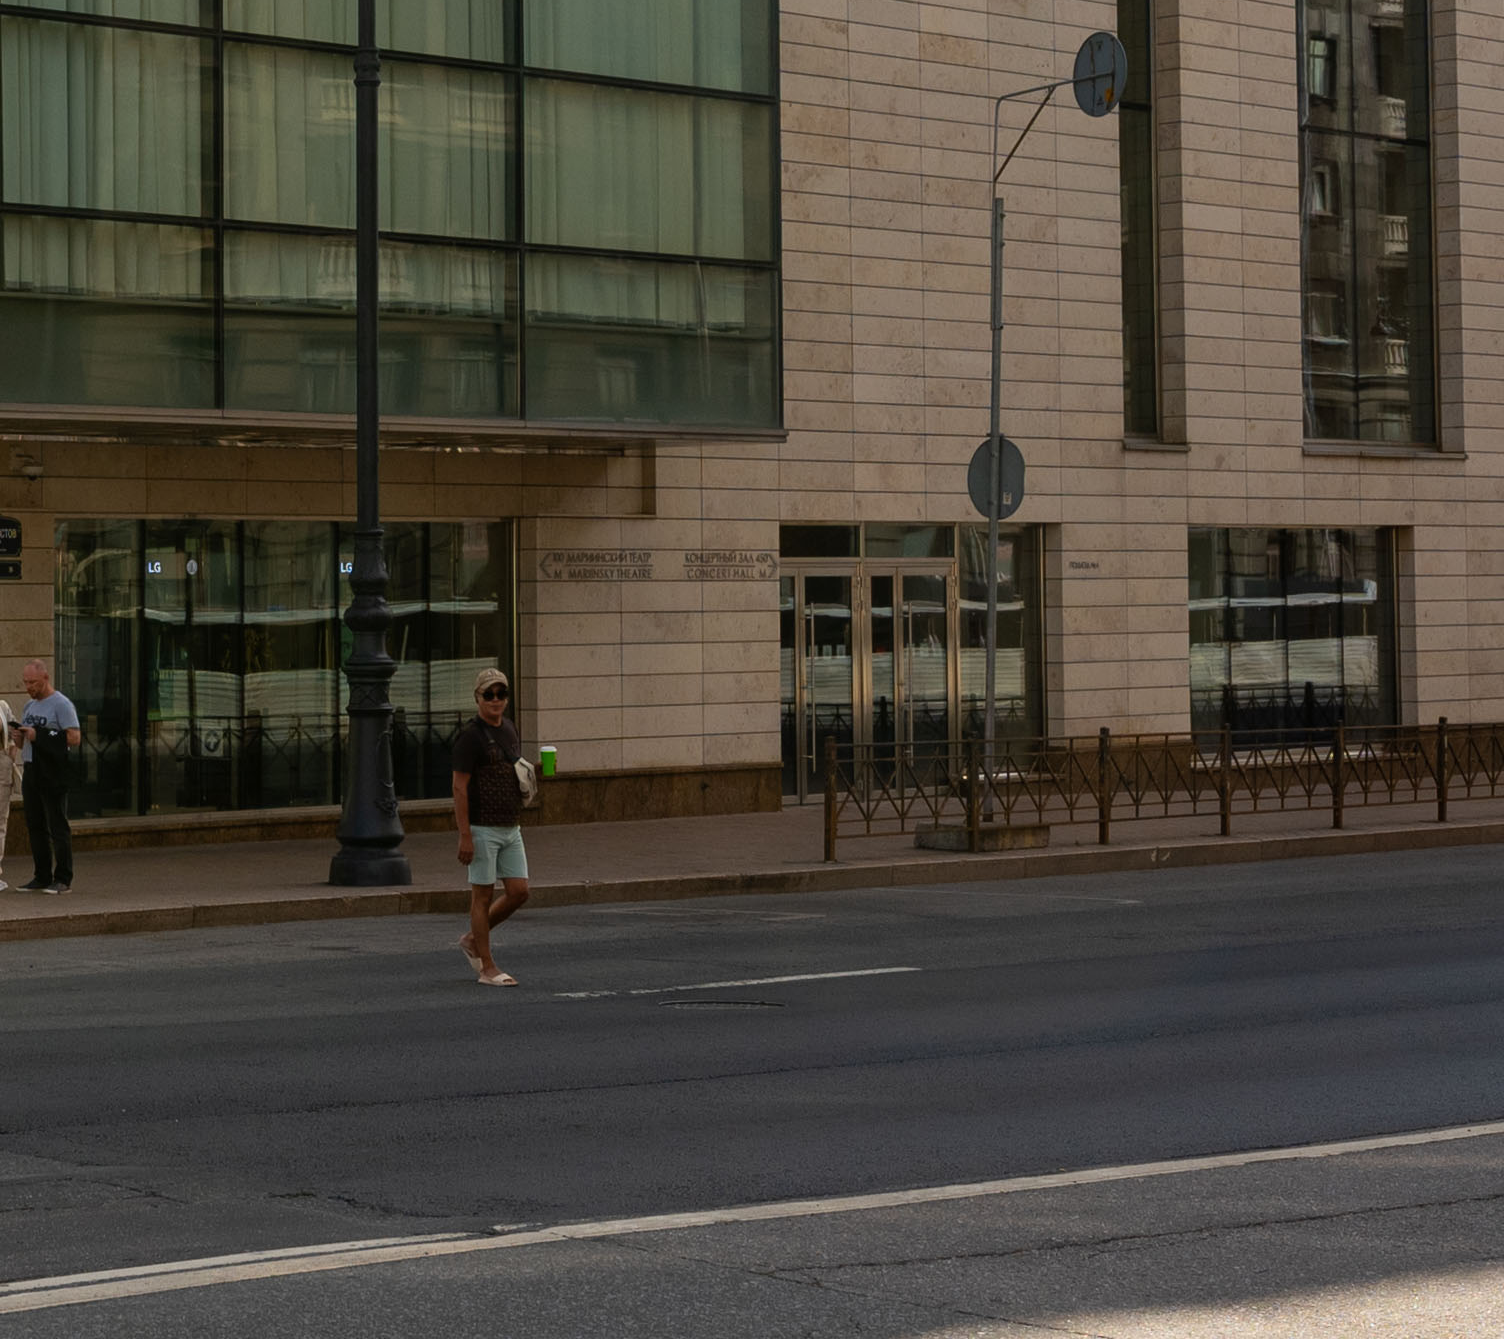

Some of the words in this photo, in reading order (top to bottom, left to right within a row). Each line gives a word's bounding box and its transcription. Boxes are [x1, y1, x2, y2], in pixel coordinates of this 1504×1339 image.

[628, 552, 653, 563] ТЕАТР
[738, 553, 754, 564] ЗАЛ
[148, 562, 161, 573] LG
[340, 562, 353, 573] LG
[616, 568, 653, 580] THEATRE
[732, 569, 755, 580] HALL
